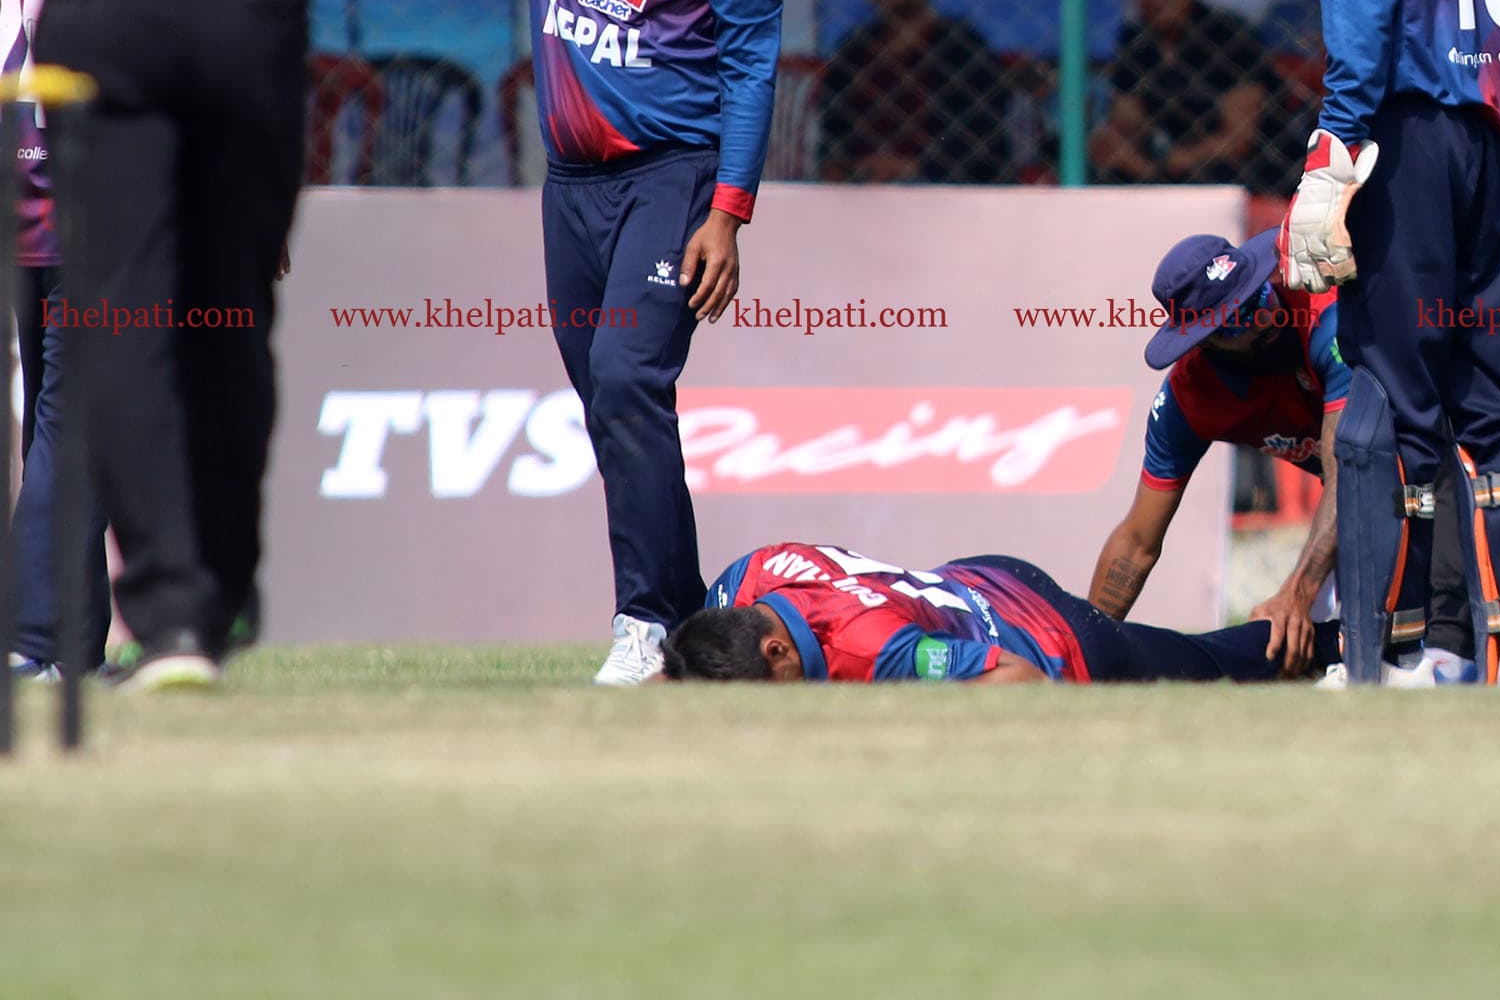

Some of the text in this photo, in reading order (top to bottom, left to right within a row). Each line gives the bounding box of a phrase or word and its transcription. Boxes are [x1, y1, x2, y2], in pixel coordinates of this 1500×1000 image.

[17, 145, 49, 160] colle
[317, 389, 1118, 499] TVS Racing
